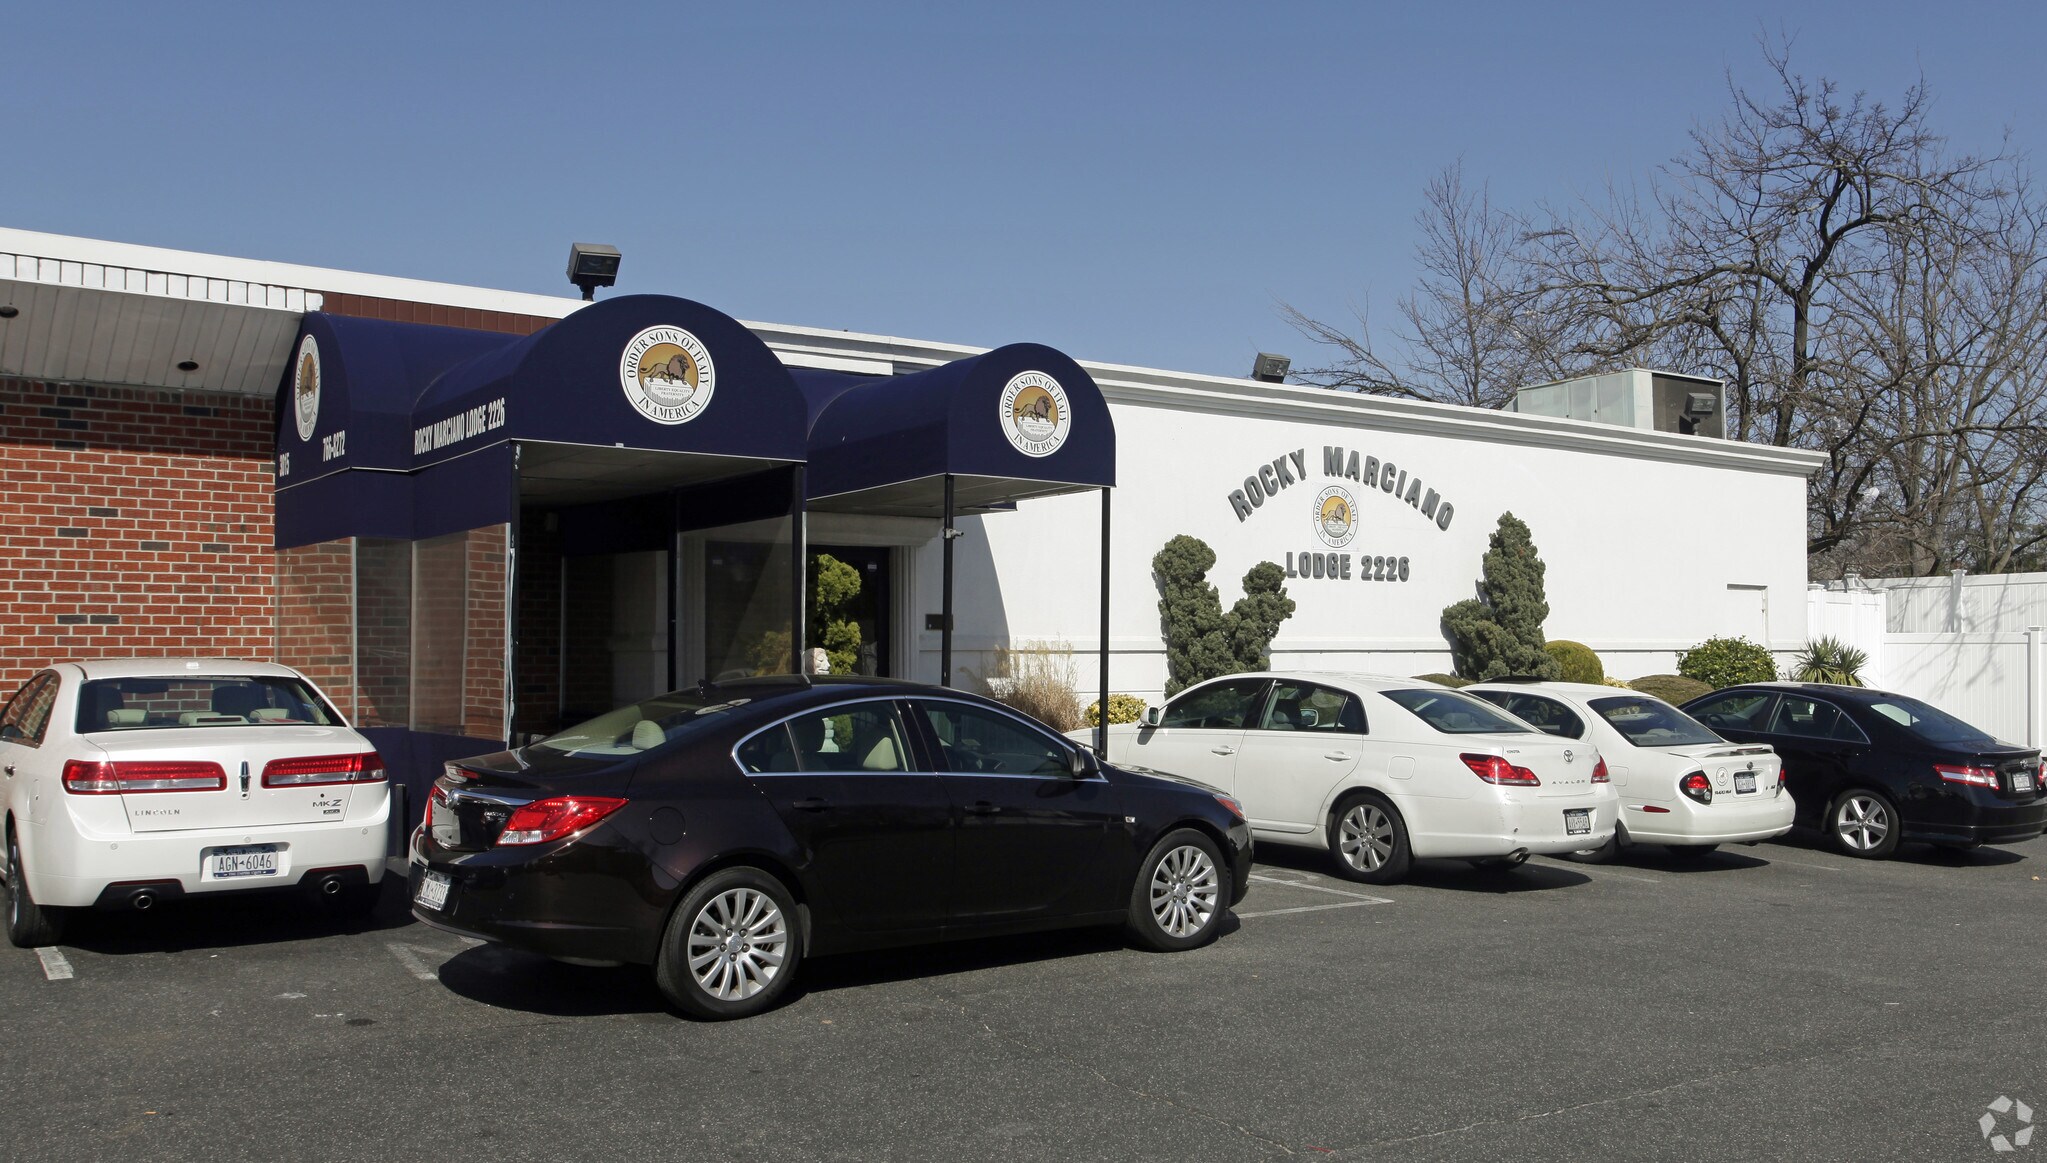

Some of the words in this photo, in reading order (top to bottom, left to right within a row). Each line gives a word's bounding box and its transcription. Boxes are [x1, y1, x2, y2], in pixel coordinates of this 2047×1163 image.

[627, 339, 649, 378] ORDER
[648, 331, 678, 344] SONS
[681, 337, 697, 351] OF
[693, 350, 709, 387] ITALY
[638, 396, 652, 410] IN
[650, 400, 700, 419] AMERICA
[1004, 383, 1020, 417] ORDER
[1020, 375, 1043, 387] SONS
[1044, 380, 1056, 392] OF
[1053, 392, 1067, 424] ITALY
[414, 424, 433, 455] ROCKY
[433, 412, 465, 449] MARCIANO
[465, 404, 486, 439] LODGE
[487, 397, 505, 431] 2226
[1014, 433, 1023, 445] IN
[1024, 436, 1059, 452] AMERICA
[1227, 448, 1307, 523] ROCKY
[1323, 445, 1455, 532] MARCIANO
[1285, 551, 1351, 580] LODGE
[1361, 555, 1410, 582] 2226
[134, 808, 181, 816] LINCOLN
